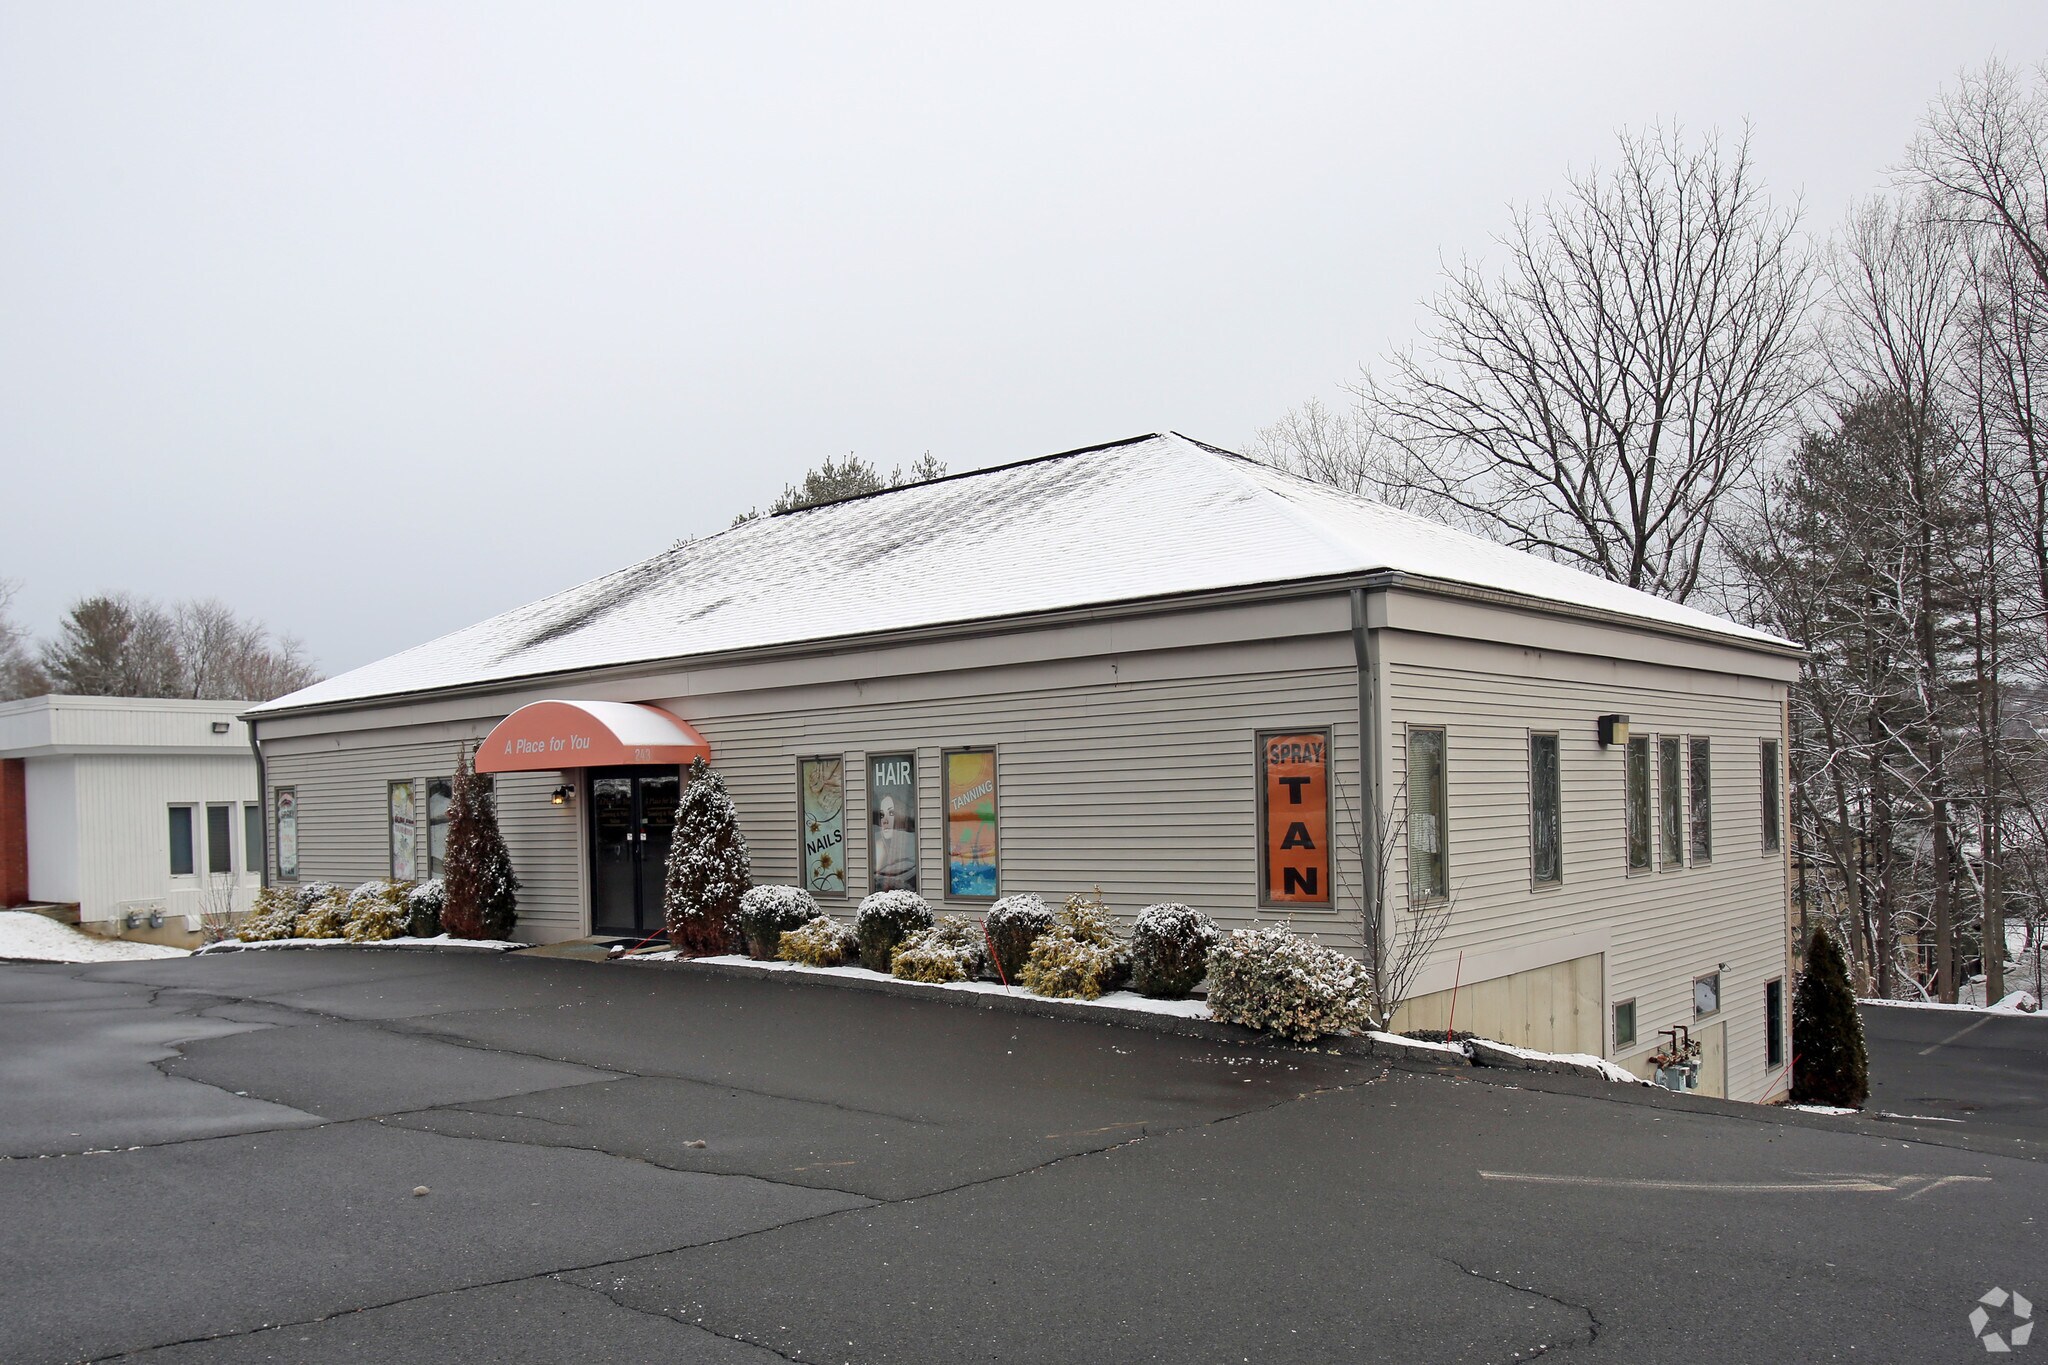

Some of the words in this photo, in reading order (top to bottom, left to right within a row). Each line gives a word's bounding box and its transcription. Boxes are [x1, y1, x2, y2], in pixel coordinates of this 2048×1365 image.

[504, 740, 512, 755] A
[516, 738, 545, 754] Place
[550, 736, 565, 751] for
[570, 734, 590, 750] You
[634, 748, 651, 762] 243
[1270, 742, 1323, 765] SPRAY
[875, 761, 912, 786] HAIR
[951, 779, 993, 811] TANNING
[806, 829, 843, 856] NAILS
[1278, 776, 1318, 895] TAN
